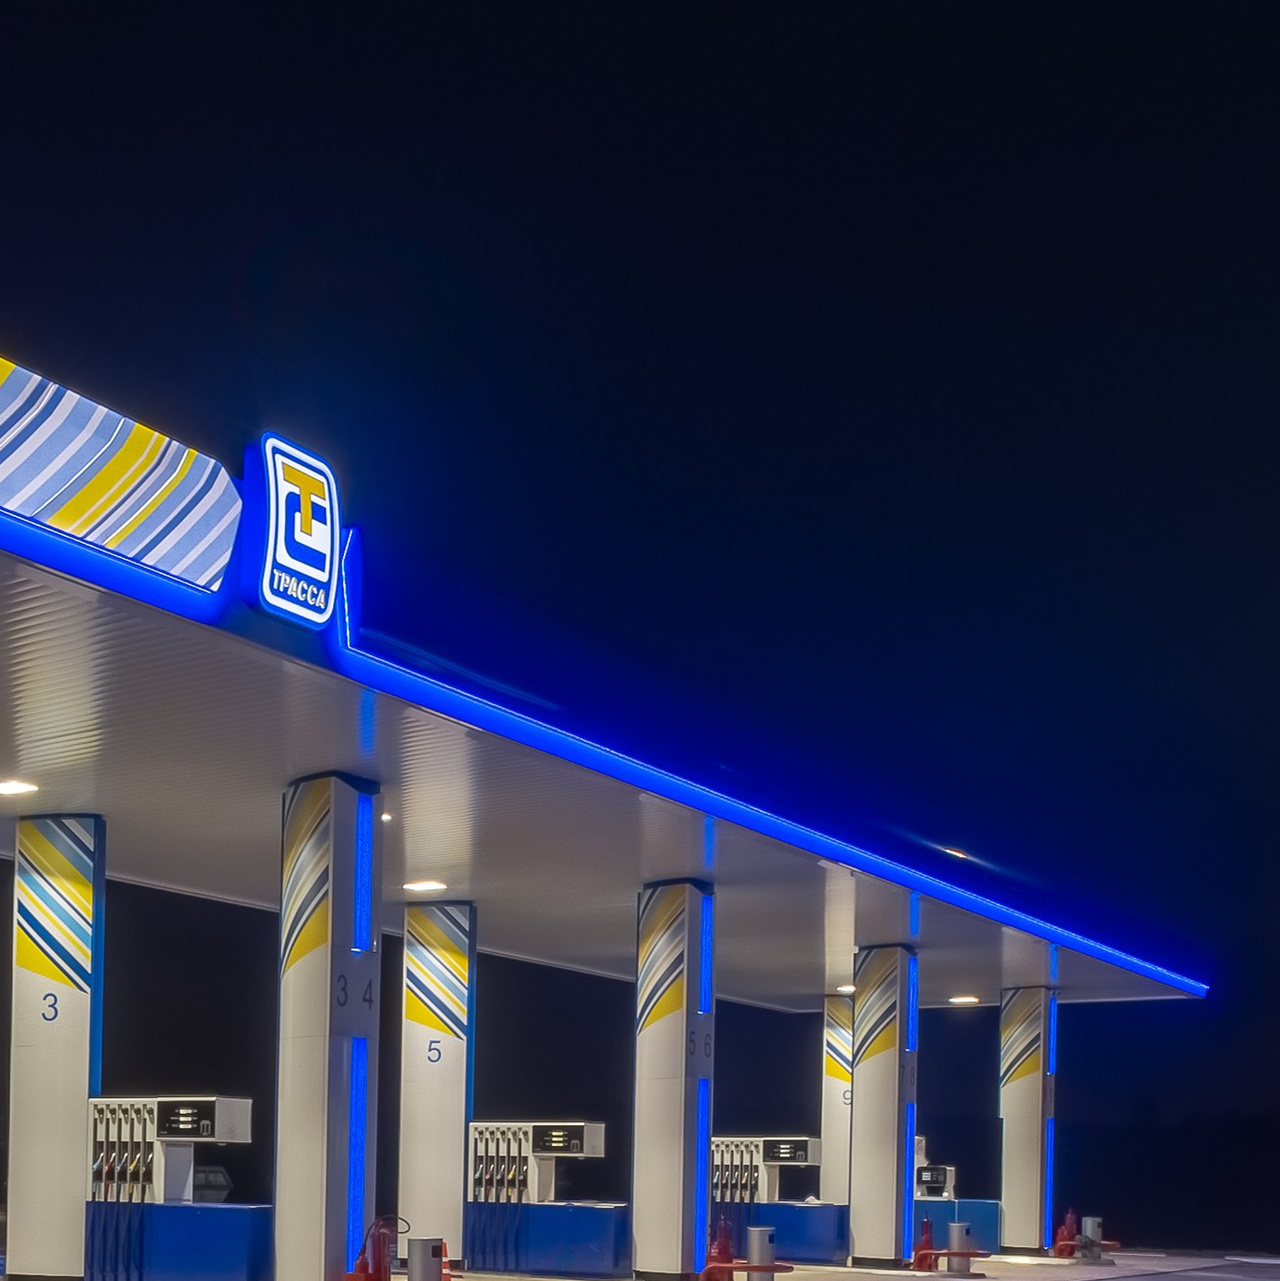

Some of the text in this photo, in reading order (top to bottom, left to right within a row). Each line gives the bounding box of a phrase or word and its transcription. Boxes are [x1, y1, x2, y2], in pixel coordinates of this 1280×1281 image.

[273, 569, 326, 609] ТРАССА
[41, 992, 59, 1022] 3
[336, 974, 374, 1011] 3 4
[427, 1040, 442, 1063] 5
[689, 1031, 712, 1058] 5 6
